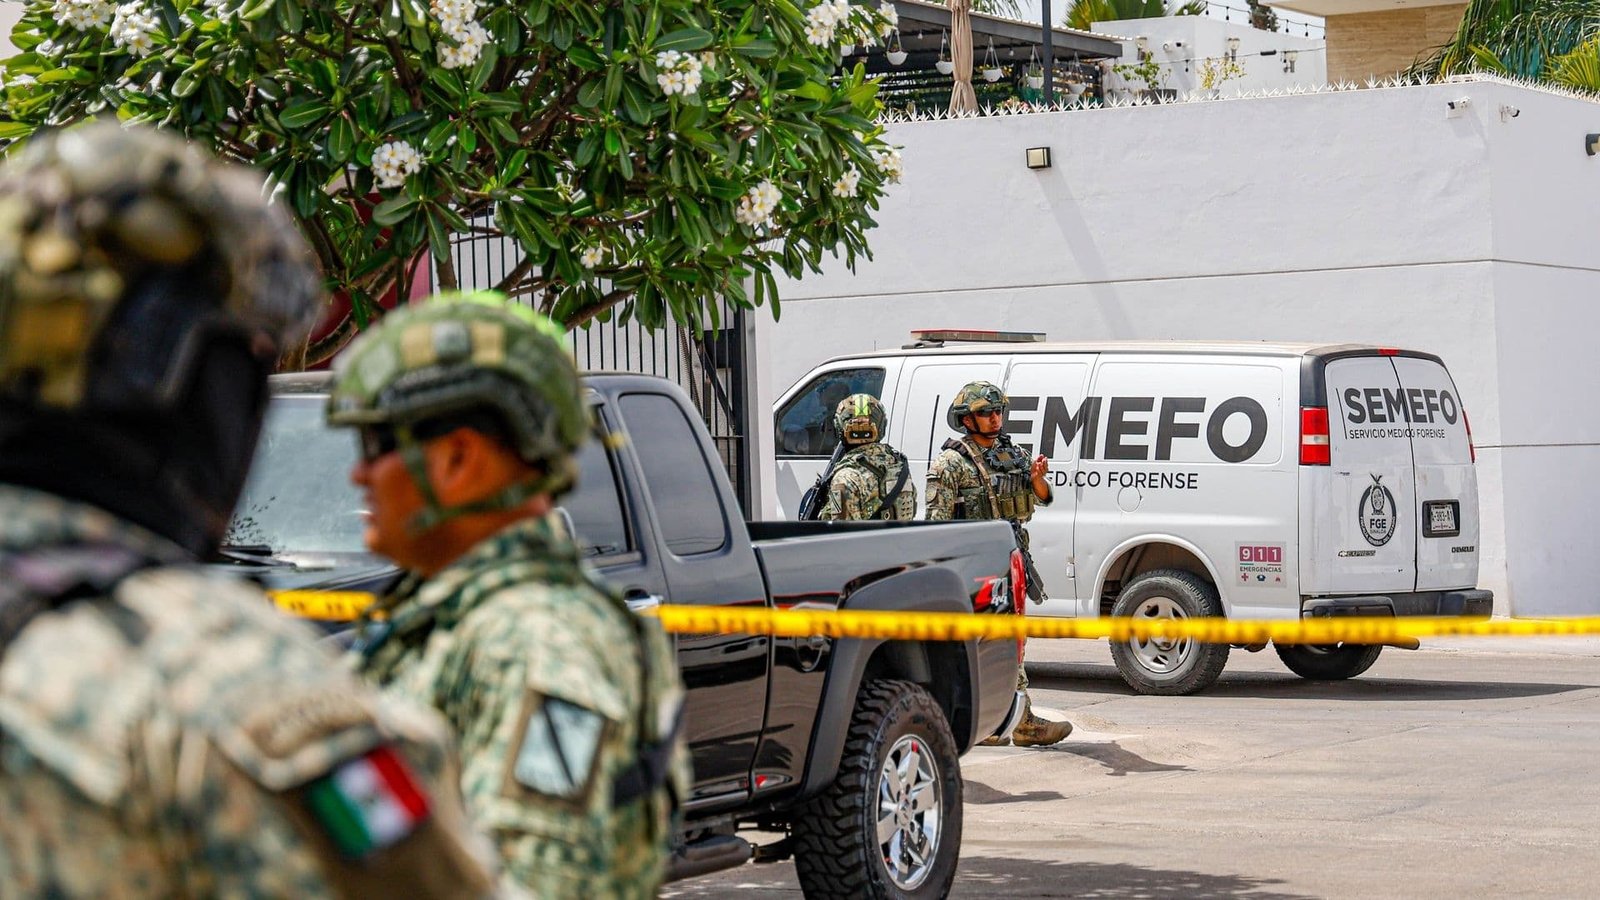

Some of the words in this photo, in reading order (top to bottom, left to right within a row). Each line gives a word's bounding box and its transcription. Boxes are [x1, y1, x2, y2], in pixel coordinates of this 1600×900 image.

[1344, 387, 1458, 425] SEMEFO
[1003, 396, 1268, 463] EMEFO
[1349, 428, 1386, 440] SERVICIO
[1387, 428, 1415, 439] MEDICO
[1416, 428, 1446, 440] FORENSE
[1107, 470, 1199, 489] FORENSE
[1369, 518, 1387, 529] FGE
[1241, 547, 1279, 562] 911
